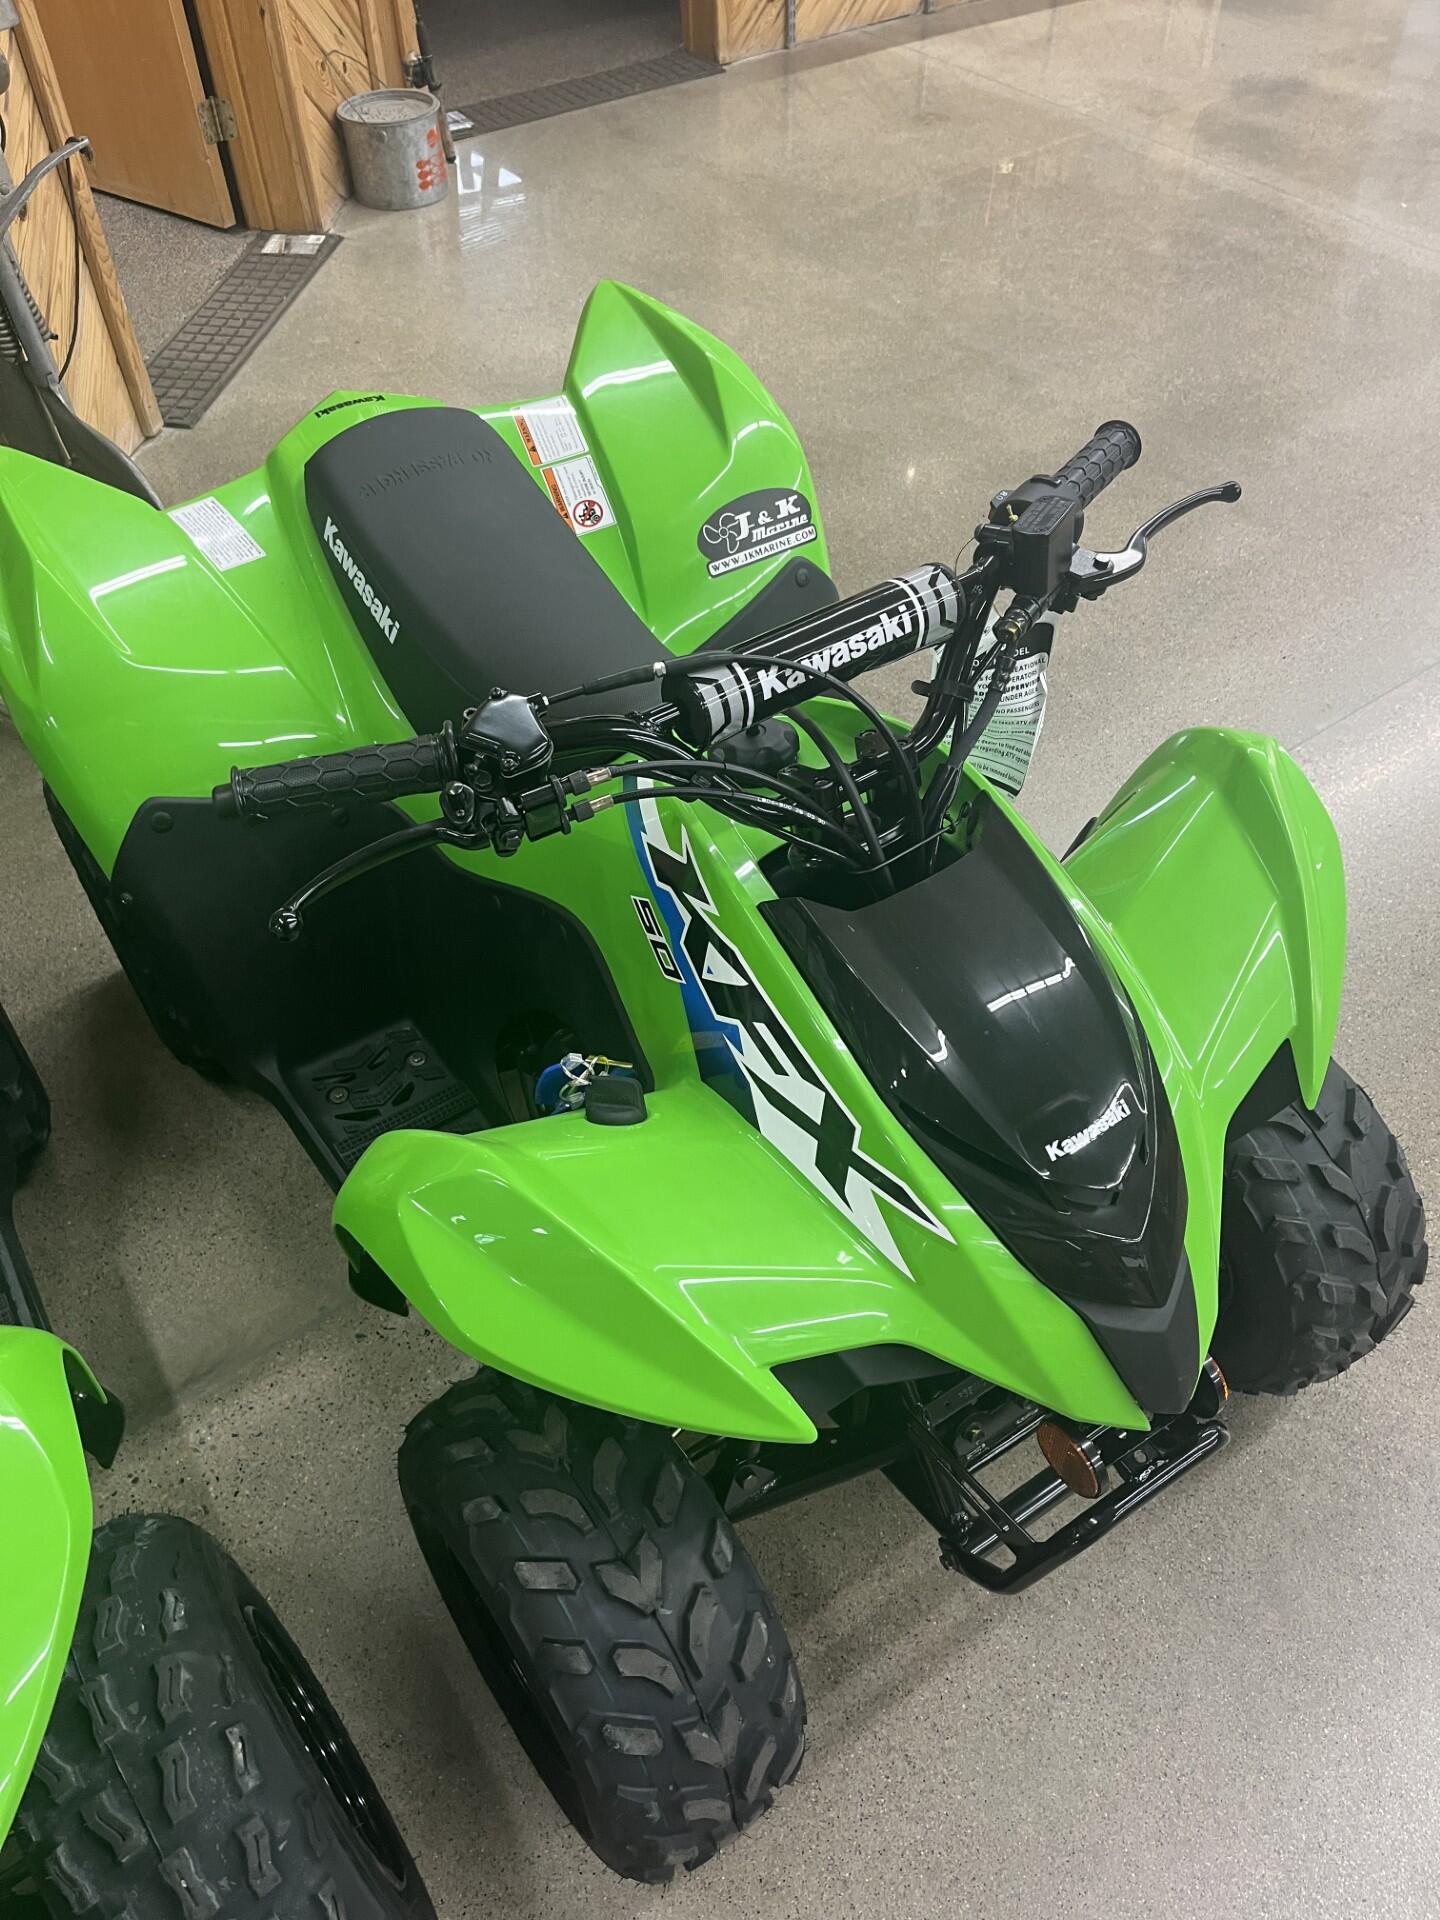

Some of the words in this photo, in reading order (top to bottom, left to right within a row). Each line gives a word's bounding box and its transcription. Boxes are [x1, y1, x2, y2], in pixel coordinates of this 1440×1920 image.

[314, 395, 386, 418] Kawasaki
[551, 484, 566, 512] WARNING
[735, 511, 755, 541] J
[757, 510, 774, 525] &
[774, 495, 801, 519] K
[711, 527, 815, 573] WWW.JKMARINE.COM
[751, 514, 809, 543] Marine
[324, 515, 400, 645] Kawasaki
[757, 604, 913, 701] Kawasaki
[1006, 701, 1040, 714] PASSENGERS
[631, 897, 684, 982] 50
[641, 824, 956, 1270] KFX
[1044, 1098, 1131, 1162] Kawasaki
